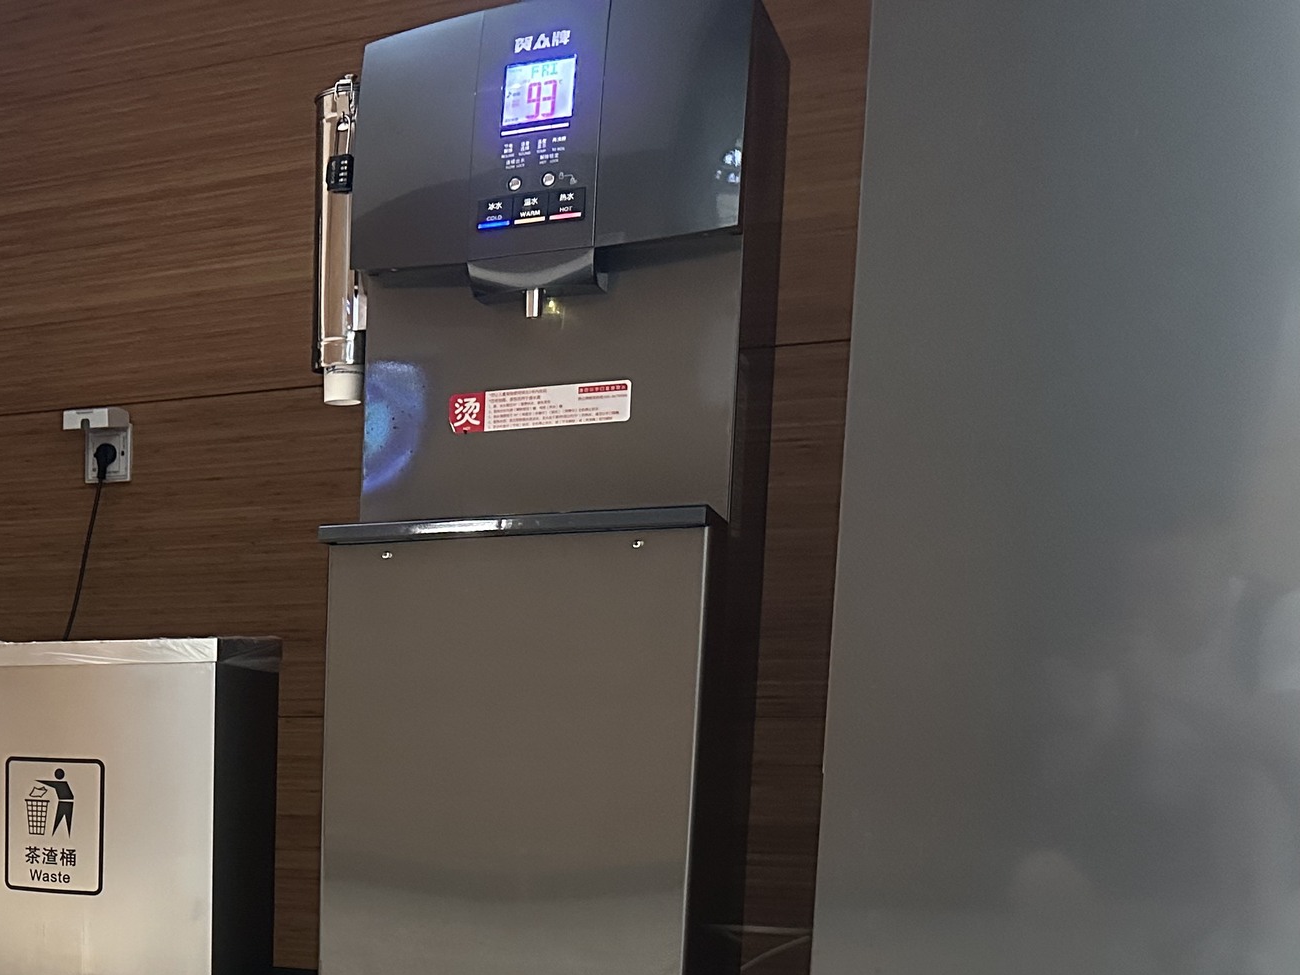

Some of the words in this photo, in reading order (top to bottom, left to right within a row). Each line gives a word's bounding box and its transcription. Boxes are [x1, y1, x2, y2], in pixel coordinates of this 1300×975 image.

[531, 63, 558, 79] FRI
[525, 80, 558, 120] 93
[486, 214, 503, 222] COLD
[519, 209, 541, 218] WARM
[453, 397, 481, 427] 烫
[24, 846, 77, 867] 茶渣桶
[29, 869, 71, 884] Waste
